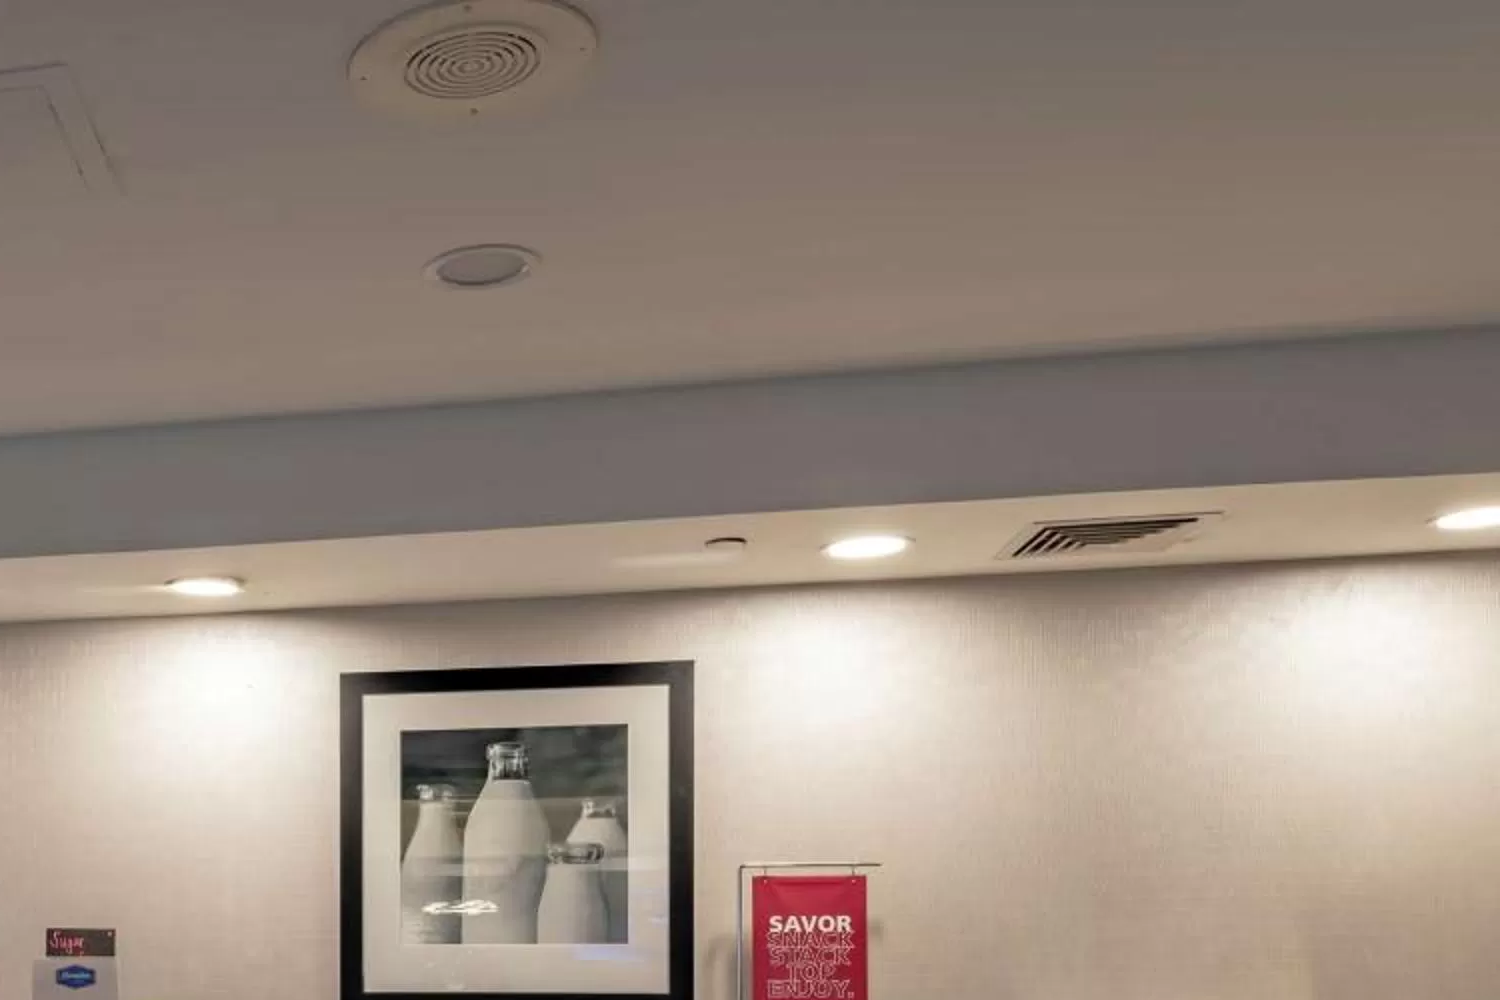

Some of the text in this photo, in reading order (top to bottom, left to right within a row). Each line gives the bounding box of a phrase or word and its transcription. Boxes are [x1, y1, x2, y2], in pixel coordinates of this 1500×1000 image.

[769, 915, 852, 933] SAVOR
[766, 930, 855, 948] SNACK
[768, 946, 852, 966] STACK
[786, 961, 837, 981] TOP
[767, 979, 855, 999] ENJOY.
